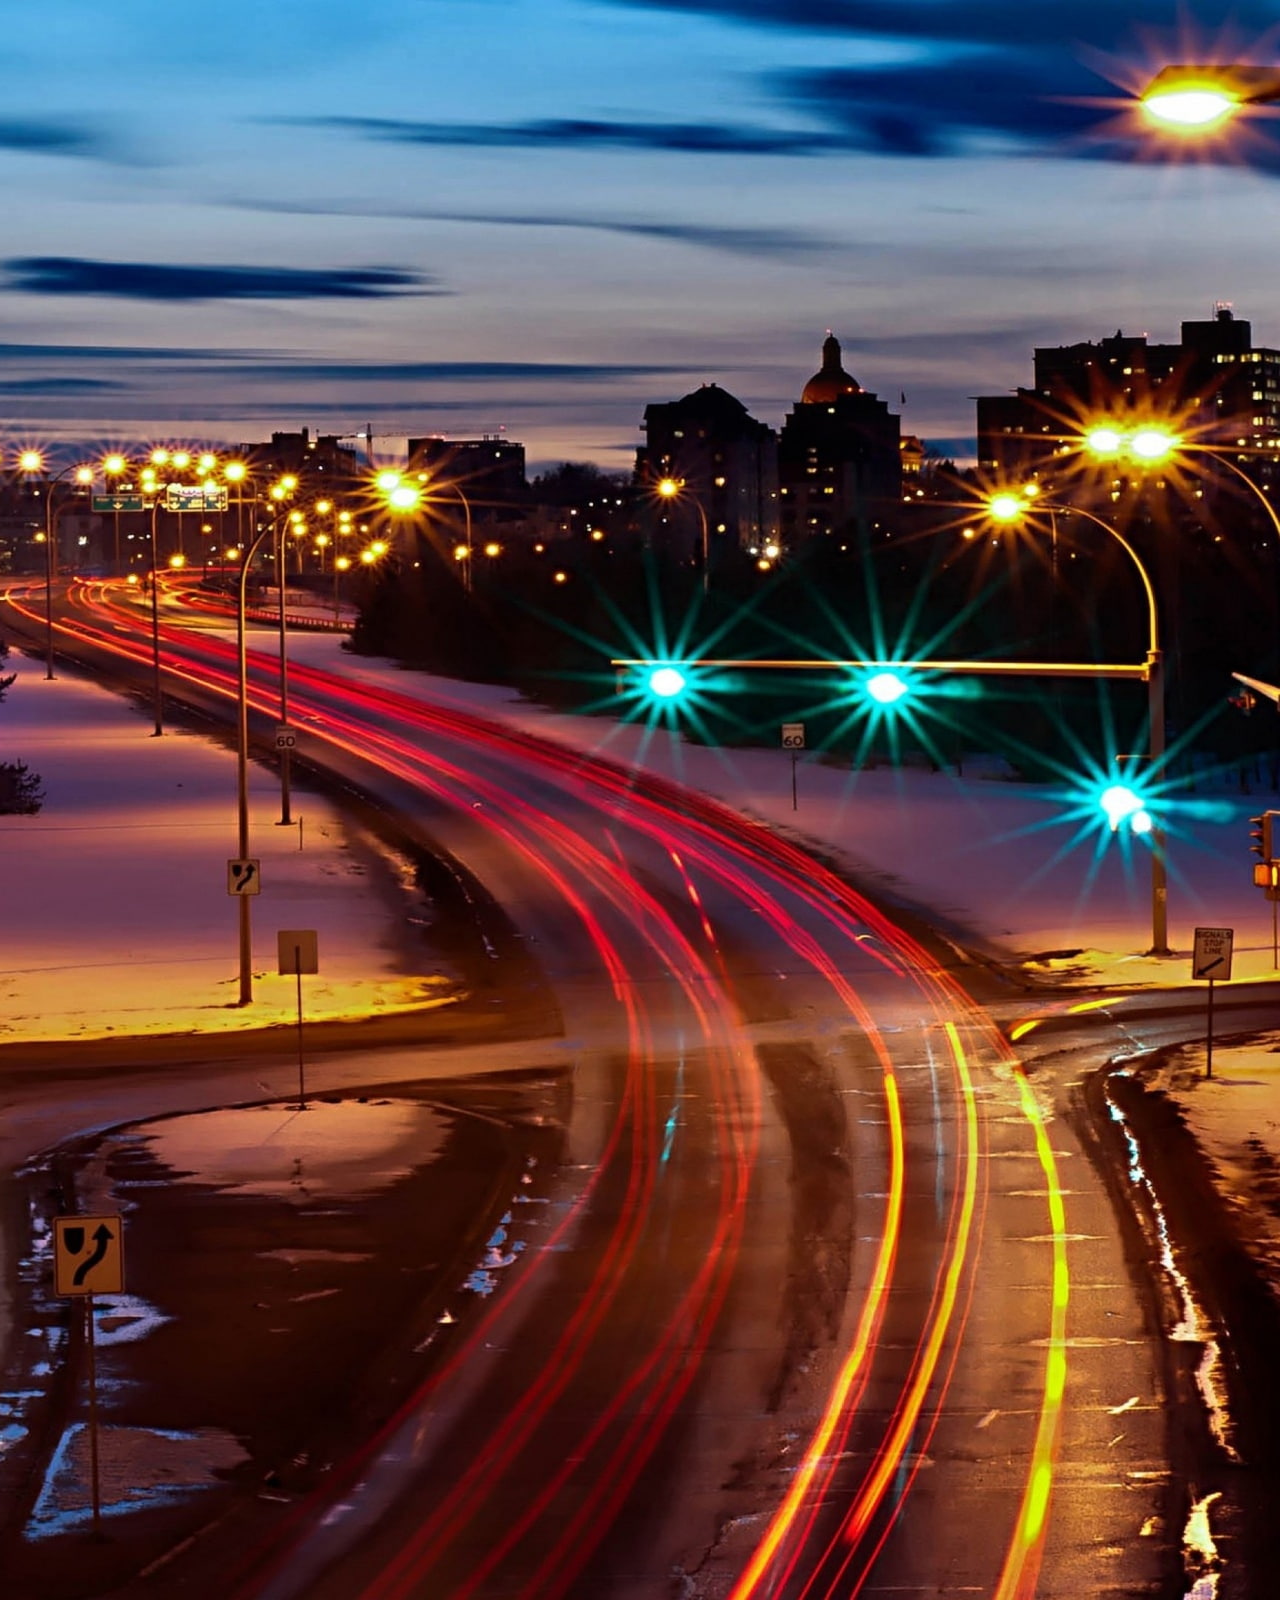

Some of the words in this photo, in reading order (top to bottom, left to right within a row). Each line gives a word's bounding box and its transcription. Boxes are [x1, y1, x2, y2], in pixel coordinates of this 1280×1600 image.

[277, 736, 295, 747] 60
[784, 735, 803, 746] 60
[1197, 931, 1231, 939] SIGNALS
